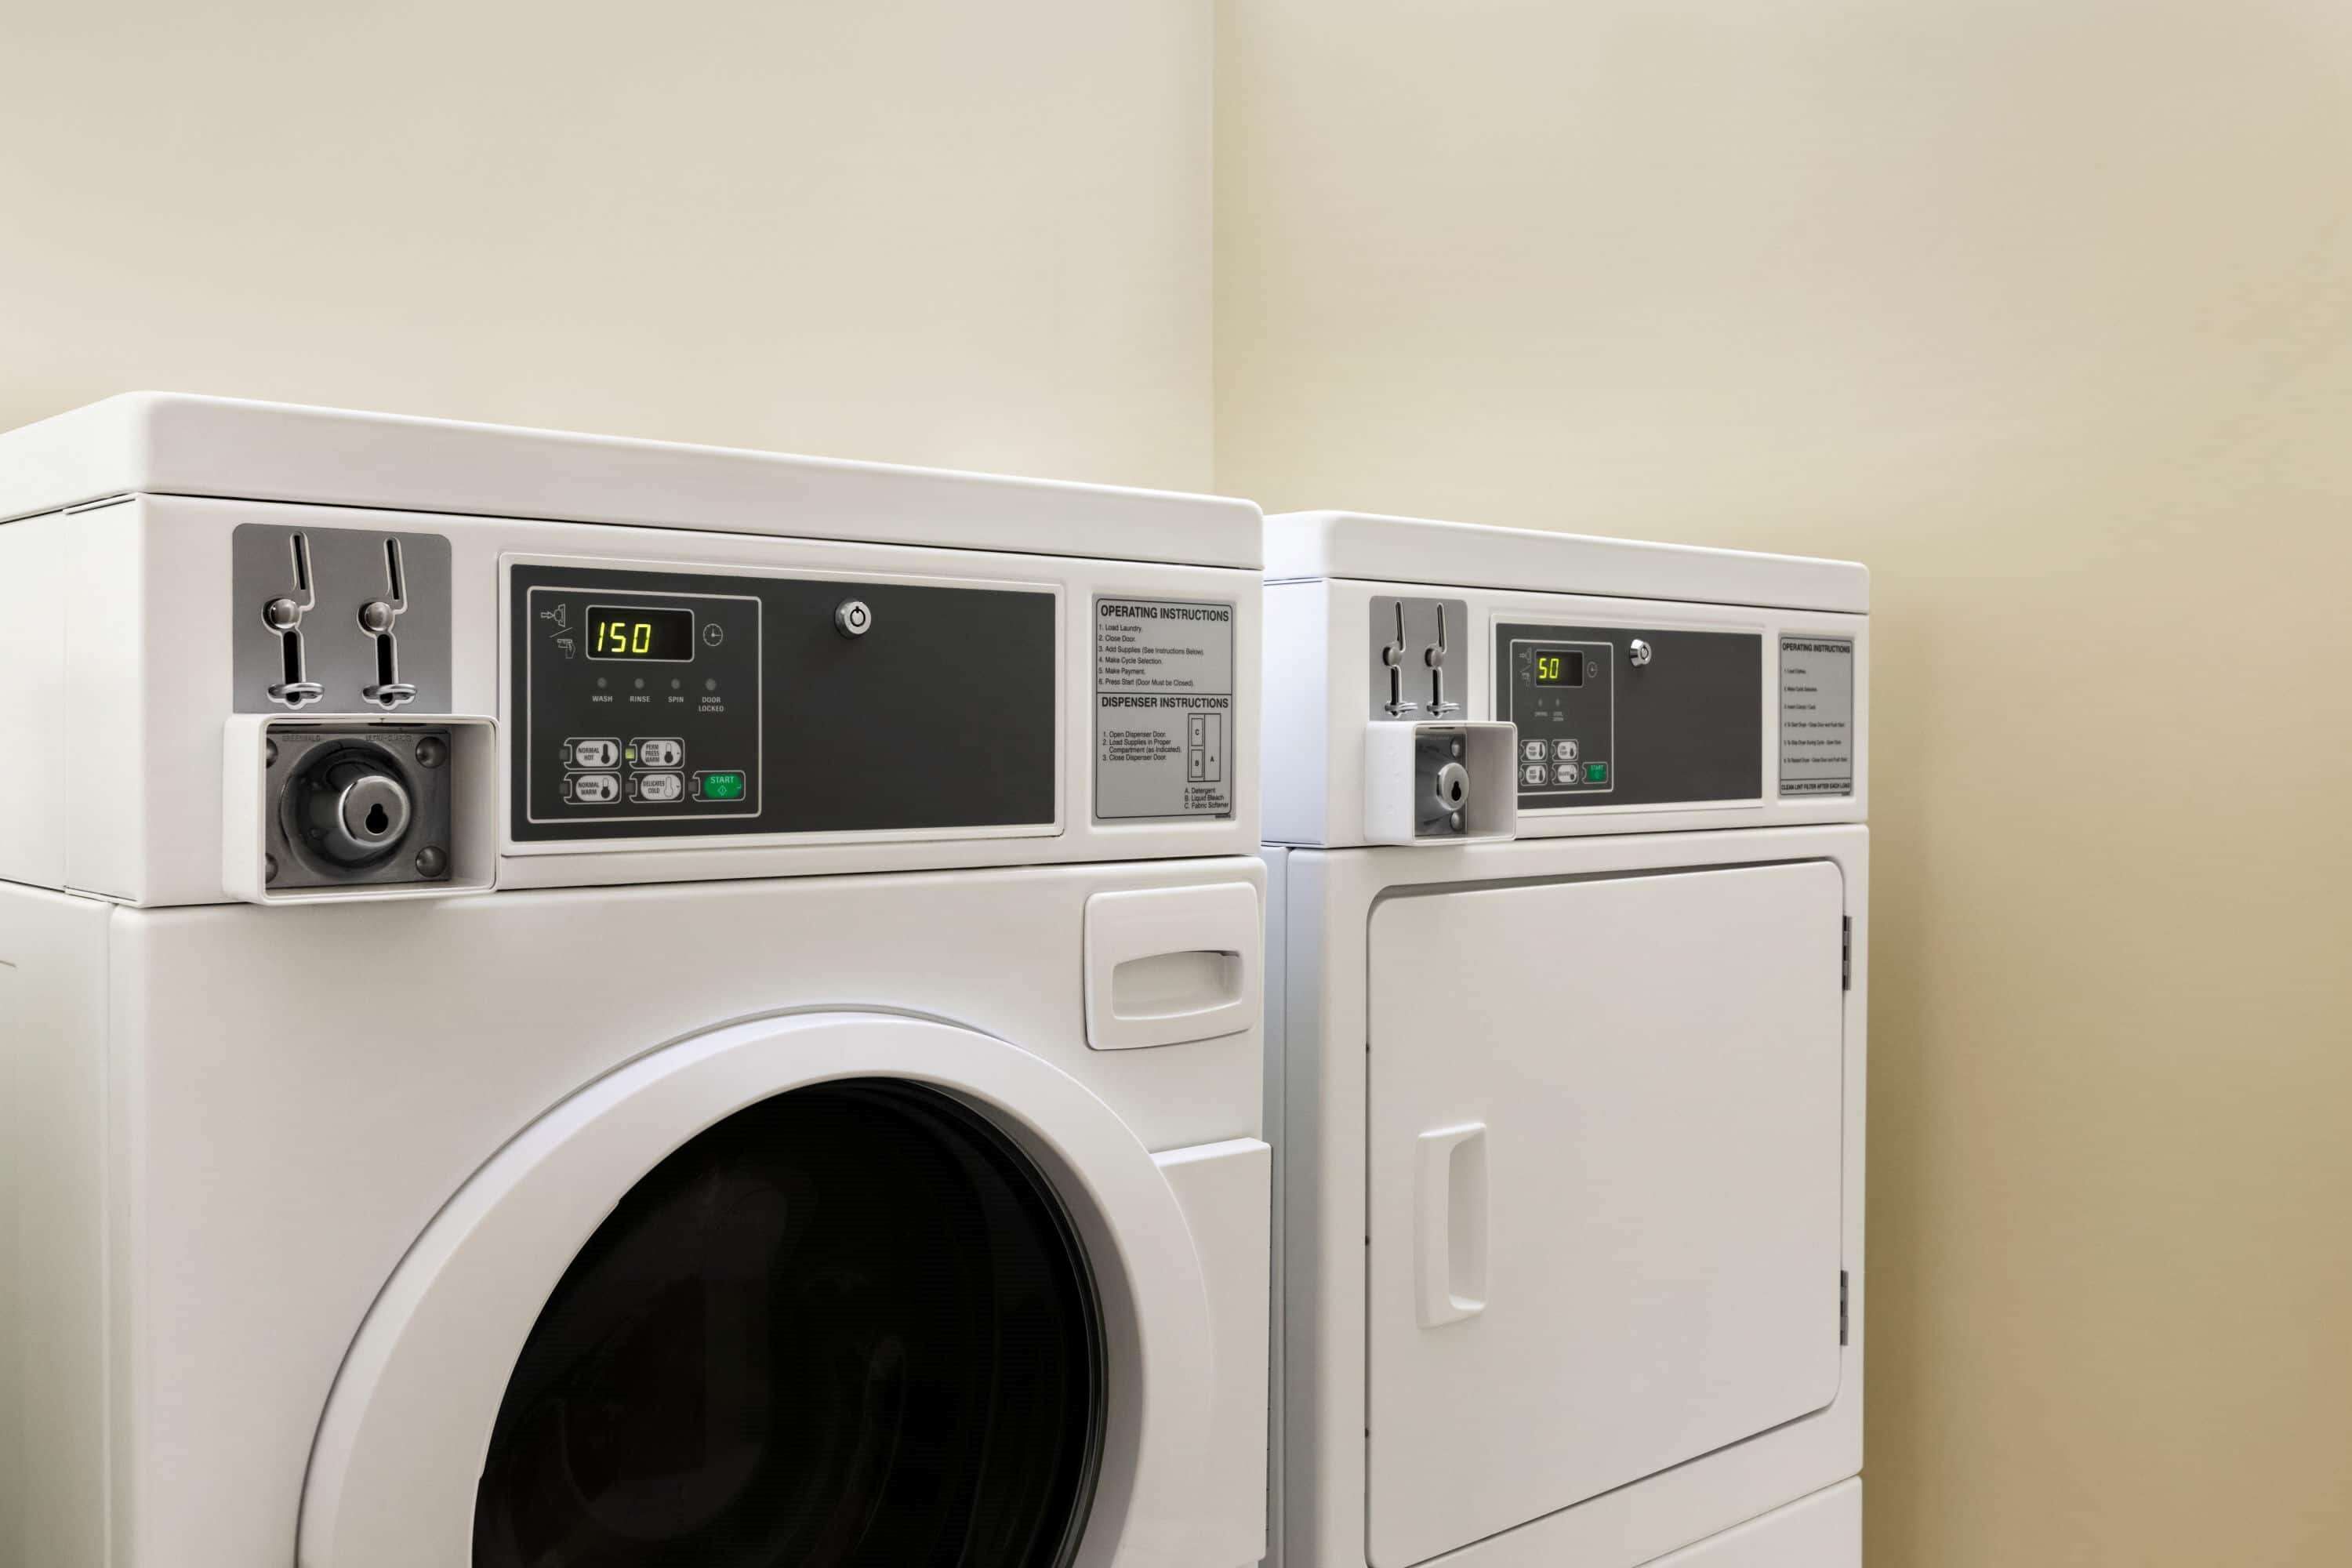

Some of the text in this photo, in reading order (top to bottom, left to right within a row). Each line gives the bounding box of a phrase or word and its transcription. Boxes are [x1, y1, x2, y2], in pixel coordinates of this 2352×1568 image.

[1101, 605, 1229, 621] OPERATING INSTRUCTIONS
[597, 622, 651, 653] 150
[1783, 643, 1850, 653] OPERATING INSTRUCTIONS
[1539, 658, 1559, 678] 50
[1102, 697, 1229, 708] DISPENSER INSTRUCTIONS
